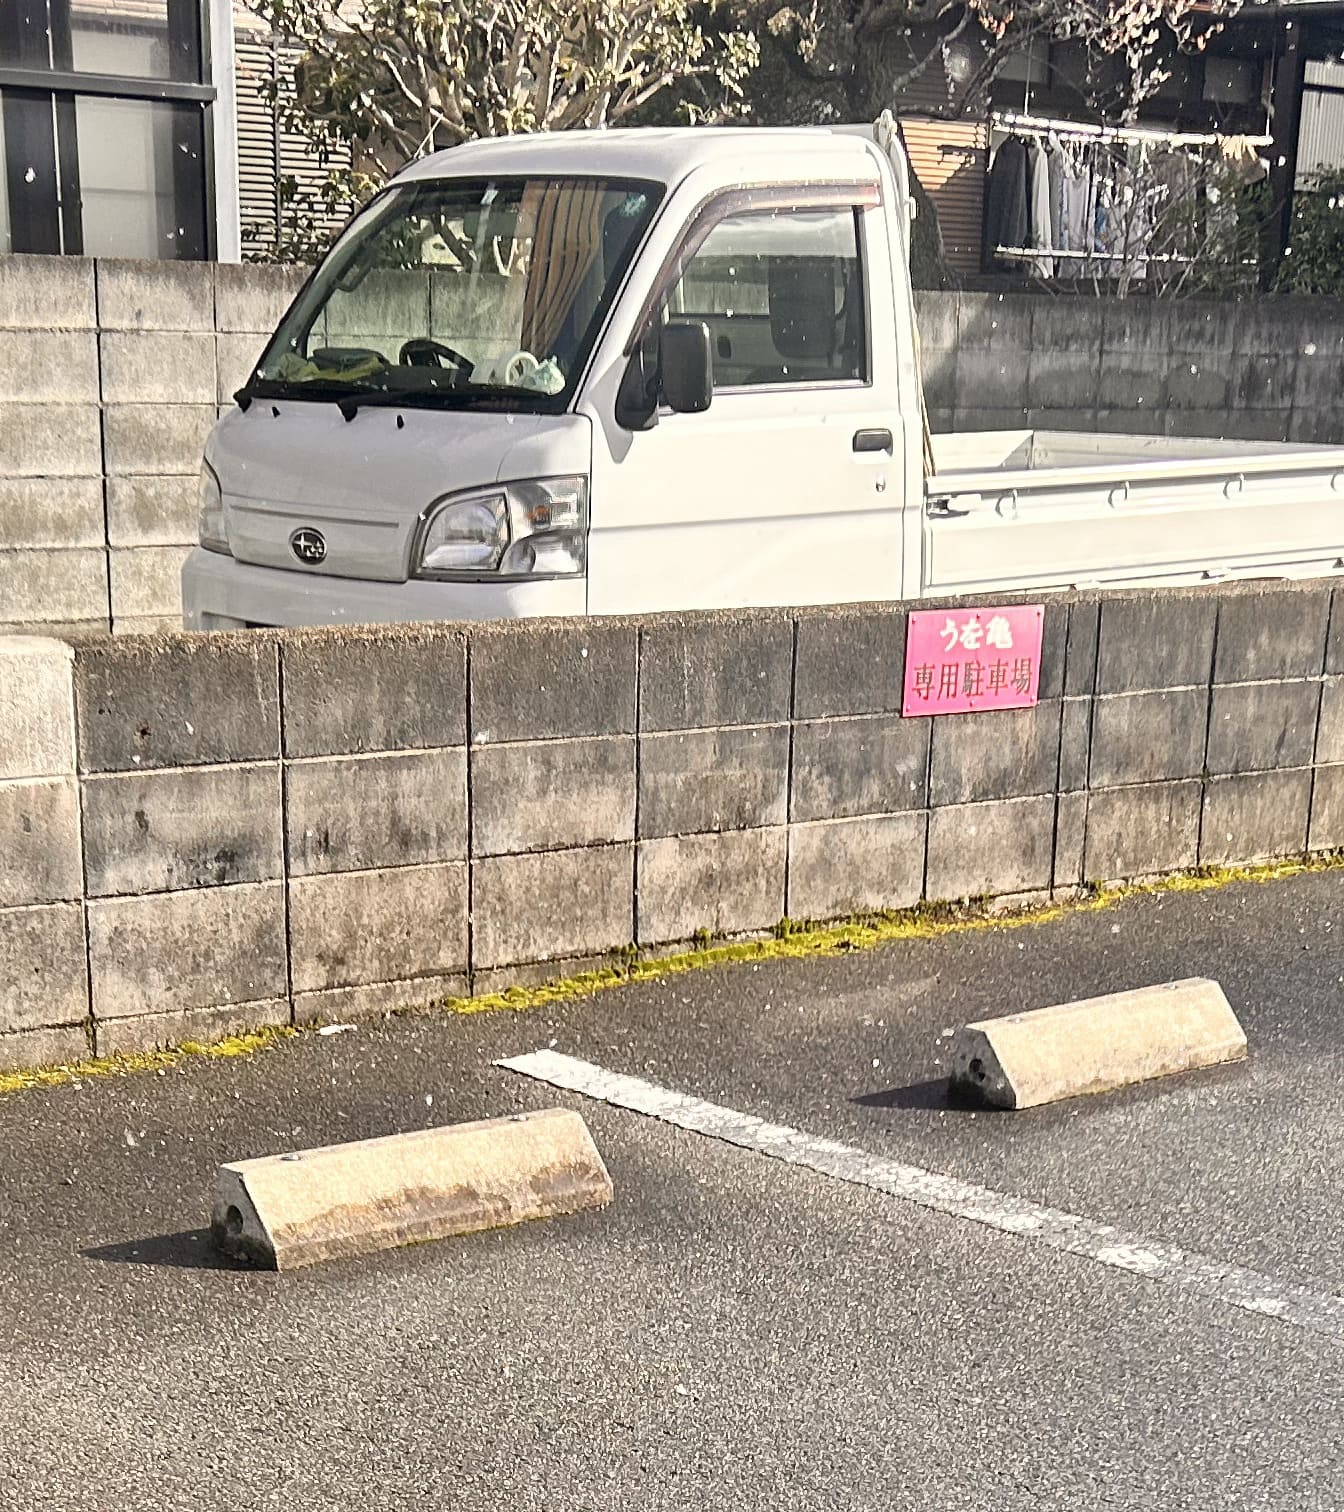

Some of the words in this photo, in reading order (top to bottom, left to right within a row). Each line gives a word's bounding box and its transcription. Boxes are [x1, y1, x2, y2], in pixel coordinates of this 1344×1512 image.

[940, 615, 1013, 652] うを亀
[912, 657, 1032, 700] 専用駐車場
